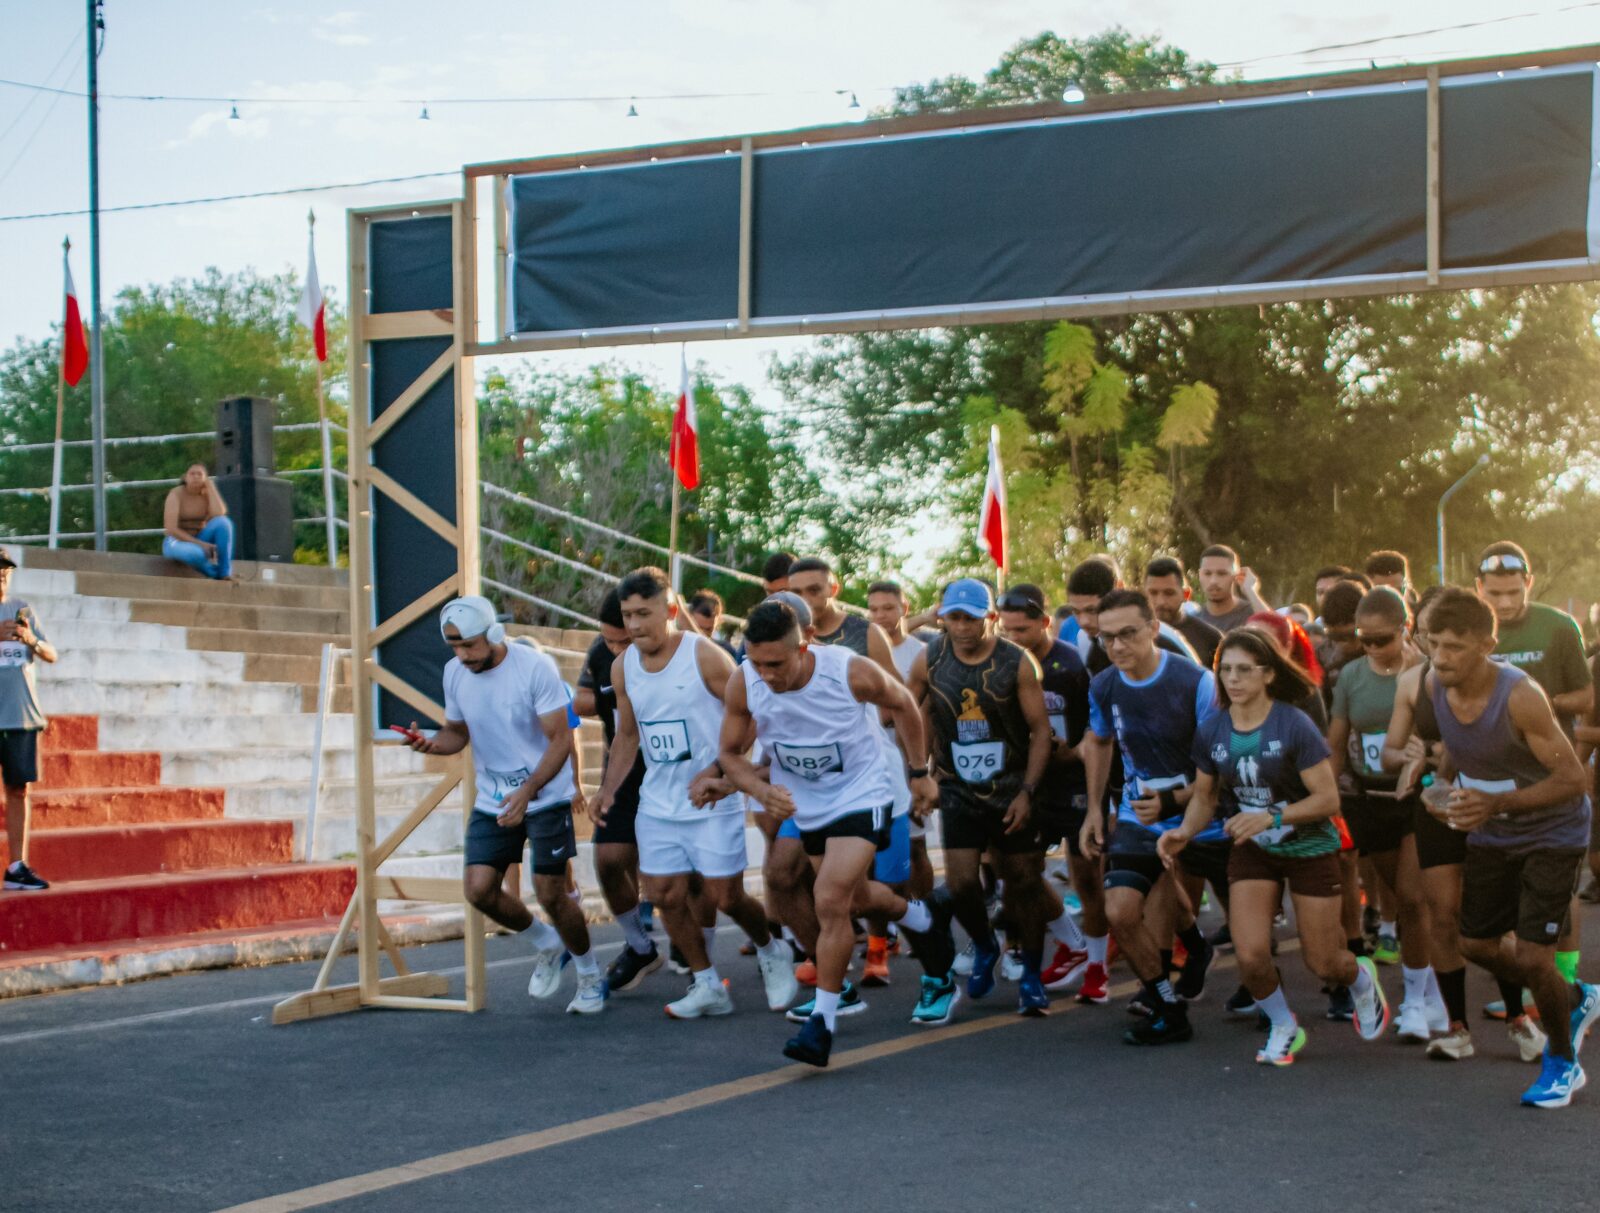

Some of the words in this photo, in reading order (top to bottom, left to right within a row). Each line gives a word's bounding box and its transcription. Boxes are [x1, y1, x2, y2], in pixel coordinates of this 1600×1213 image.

[650, 735, 674, 749] 011
[786, 756, 832, 769] 082
[957, 753, 996, 768] 076
